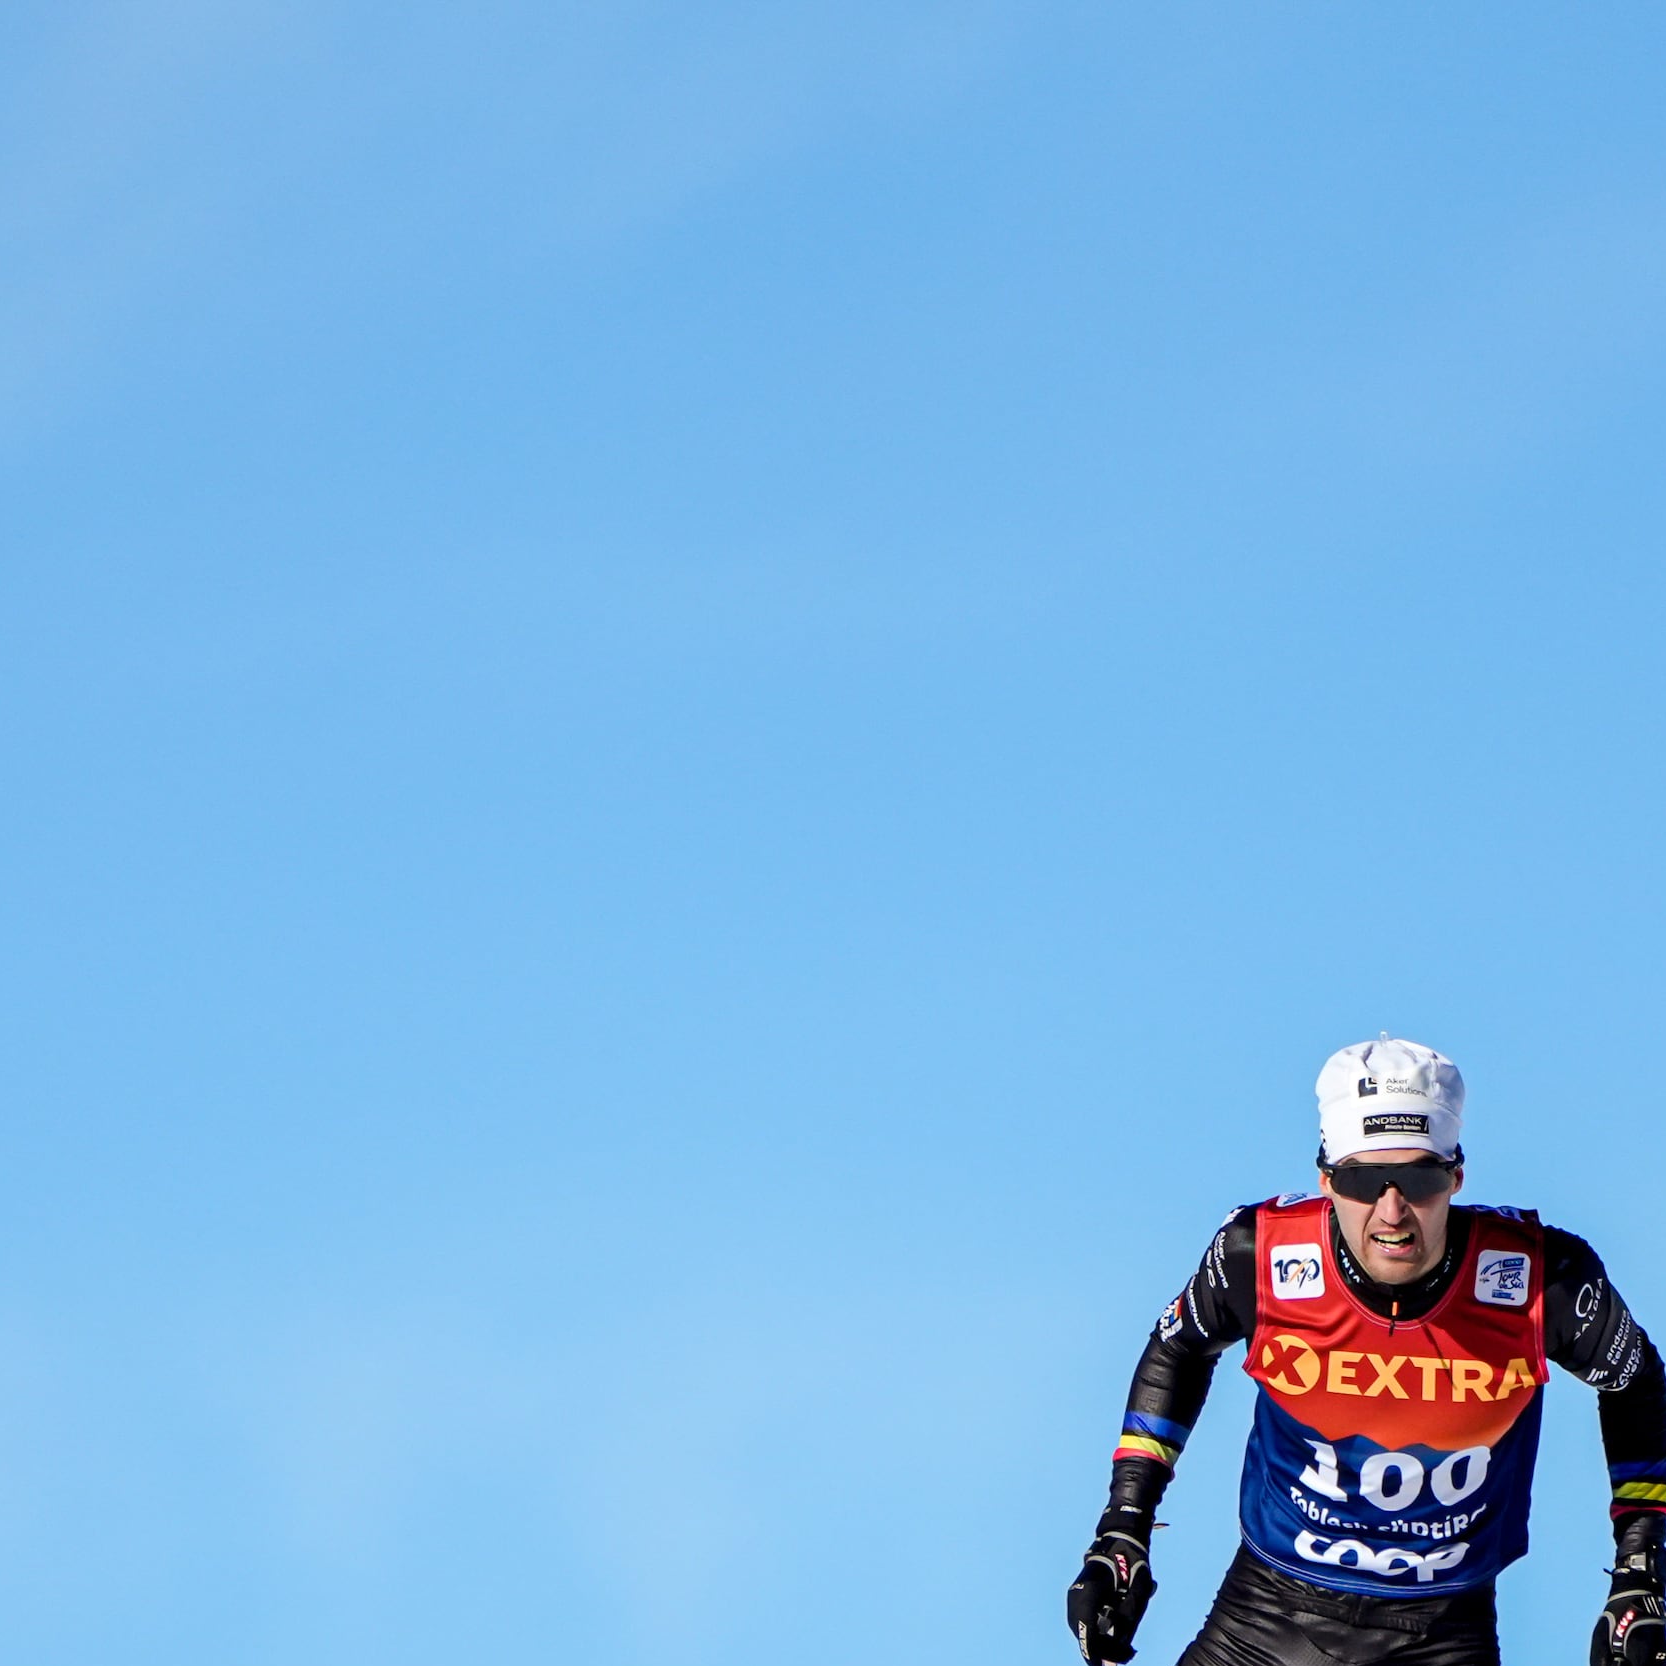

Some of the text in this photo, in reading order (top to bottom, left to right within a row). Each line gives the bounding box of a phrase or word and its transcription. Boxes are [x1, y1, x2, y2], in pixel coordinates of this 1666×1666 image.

[1364, 1116, 1422, 1126] ANDBANK
[1606, 1309, 1627, 1361] andorra
[1326, 1350, 1536, 1403] EXTRA
[1299, 1439, 1491, 1511] 100
[1294, 1530, 1470, 1583] coop
